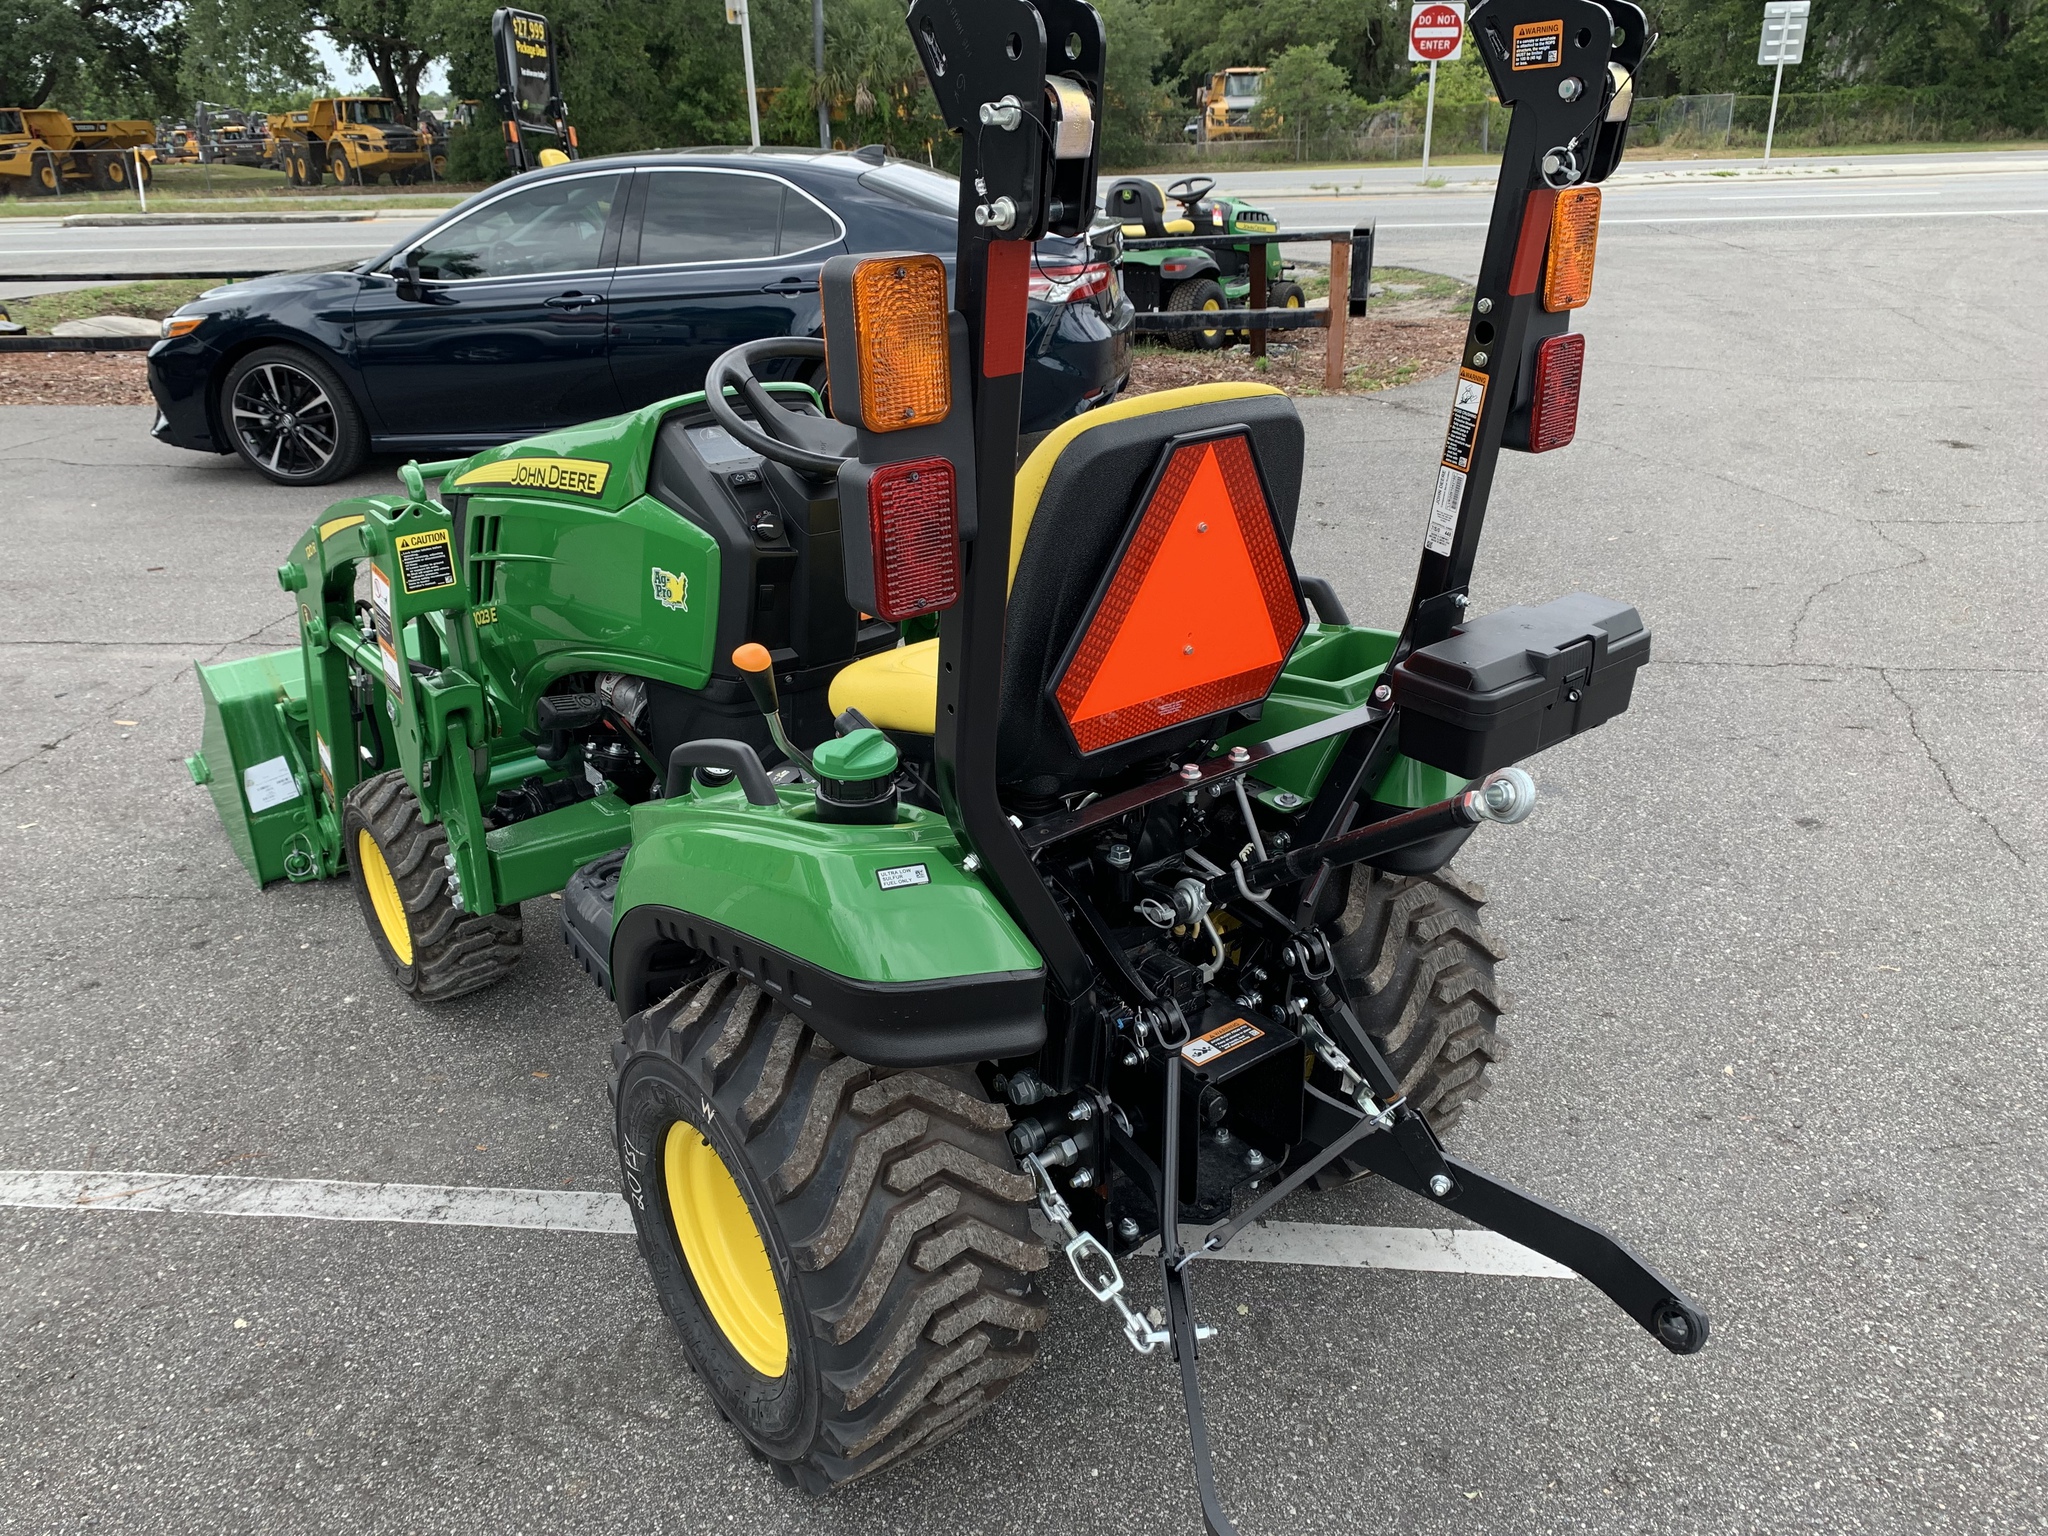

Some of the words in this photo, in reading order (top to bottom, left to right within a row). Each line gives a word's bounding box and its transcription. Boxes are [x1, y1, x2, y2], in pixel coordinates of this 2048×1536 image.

[1419, 15, 1431, 25] DO
[1437, 15, 1456, 24] NOT
[1525, 24, 1558, 34] WARNING
[1420, 40, 1450, 49] ENTER
[1465, 372, 1486, 383] WARNING
[511, 463, 546, 484] JOHN
[549, 465, 597, 490] DEERE
[411, 532, 446, 545] CAUTION
